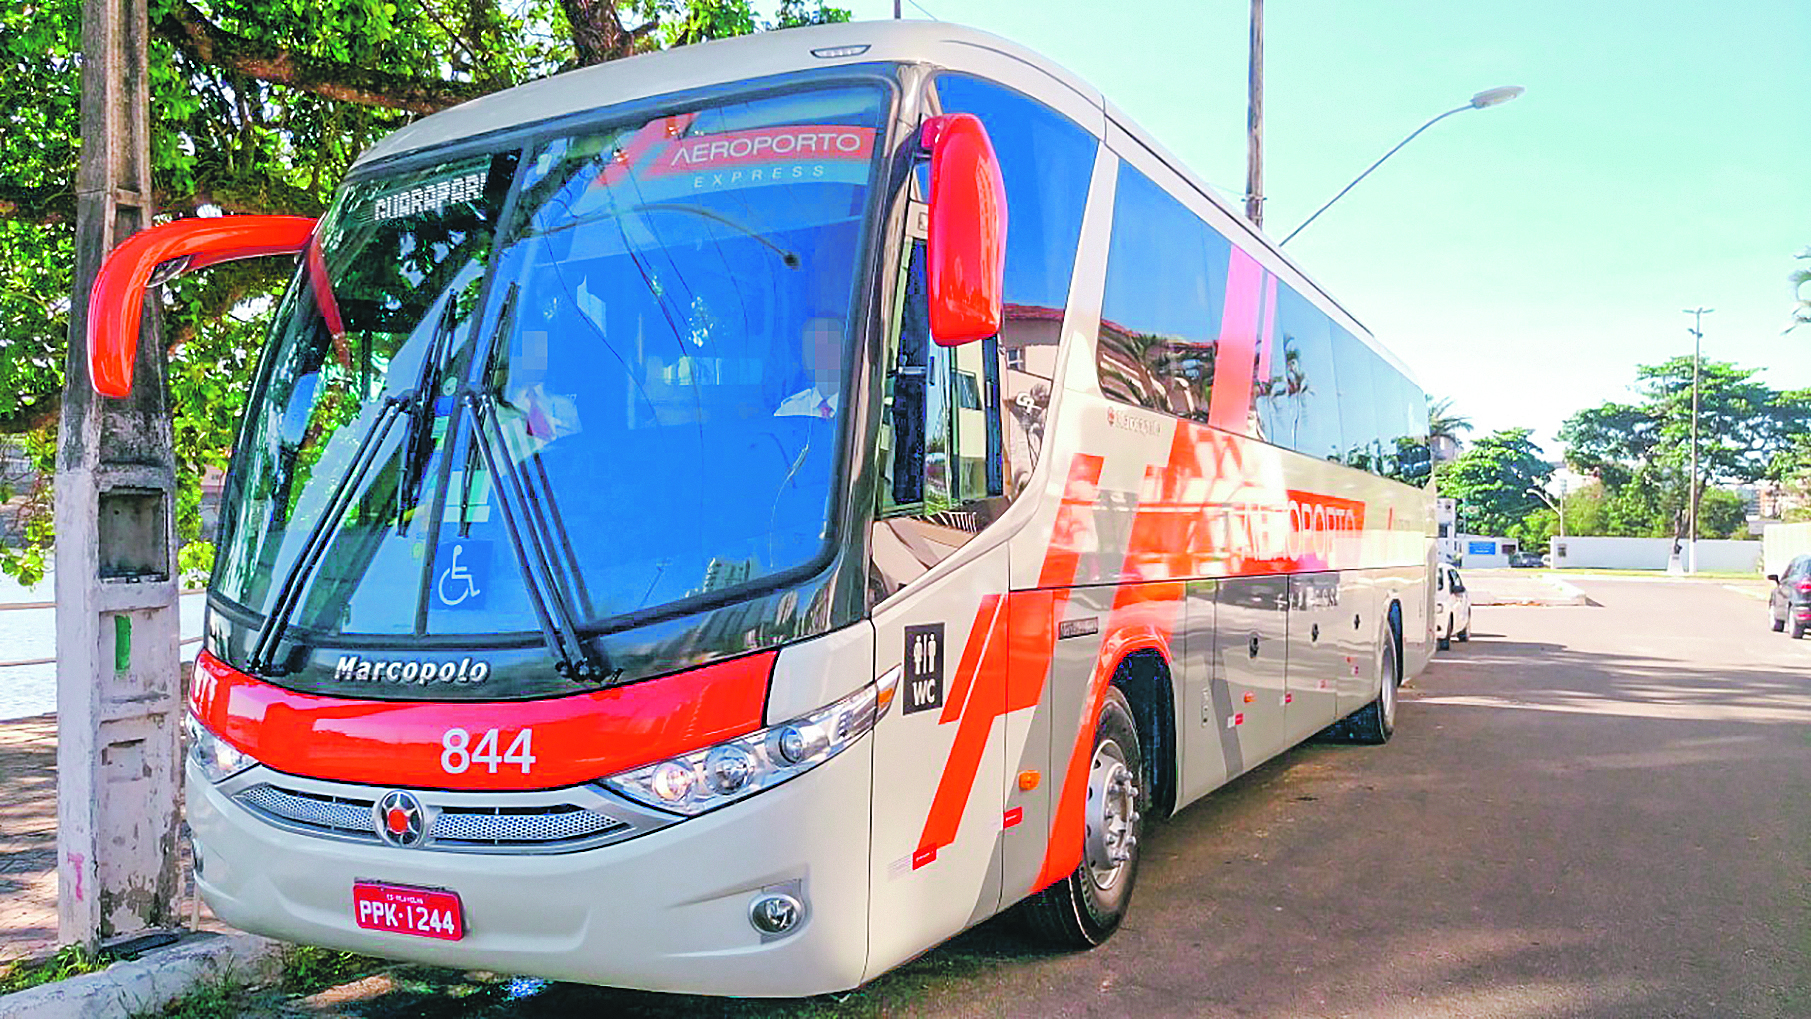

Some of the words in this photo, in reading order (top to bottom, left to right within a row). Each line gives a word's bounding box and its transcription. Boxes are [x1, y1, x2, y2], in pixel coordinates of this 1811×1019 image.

[670, 132, 861, 166] AEROPORTO
[694, 165, 825, 189] EXPRESS
[334, 655, 489, 685] Marcopolo
[912, 678, 936, 707] WC
[440, 727, 536, 774] 844
